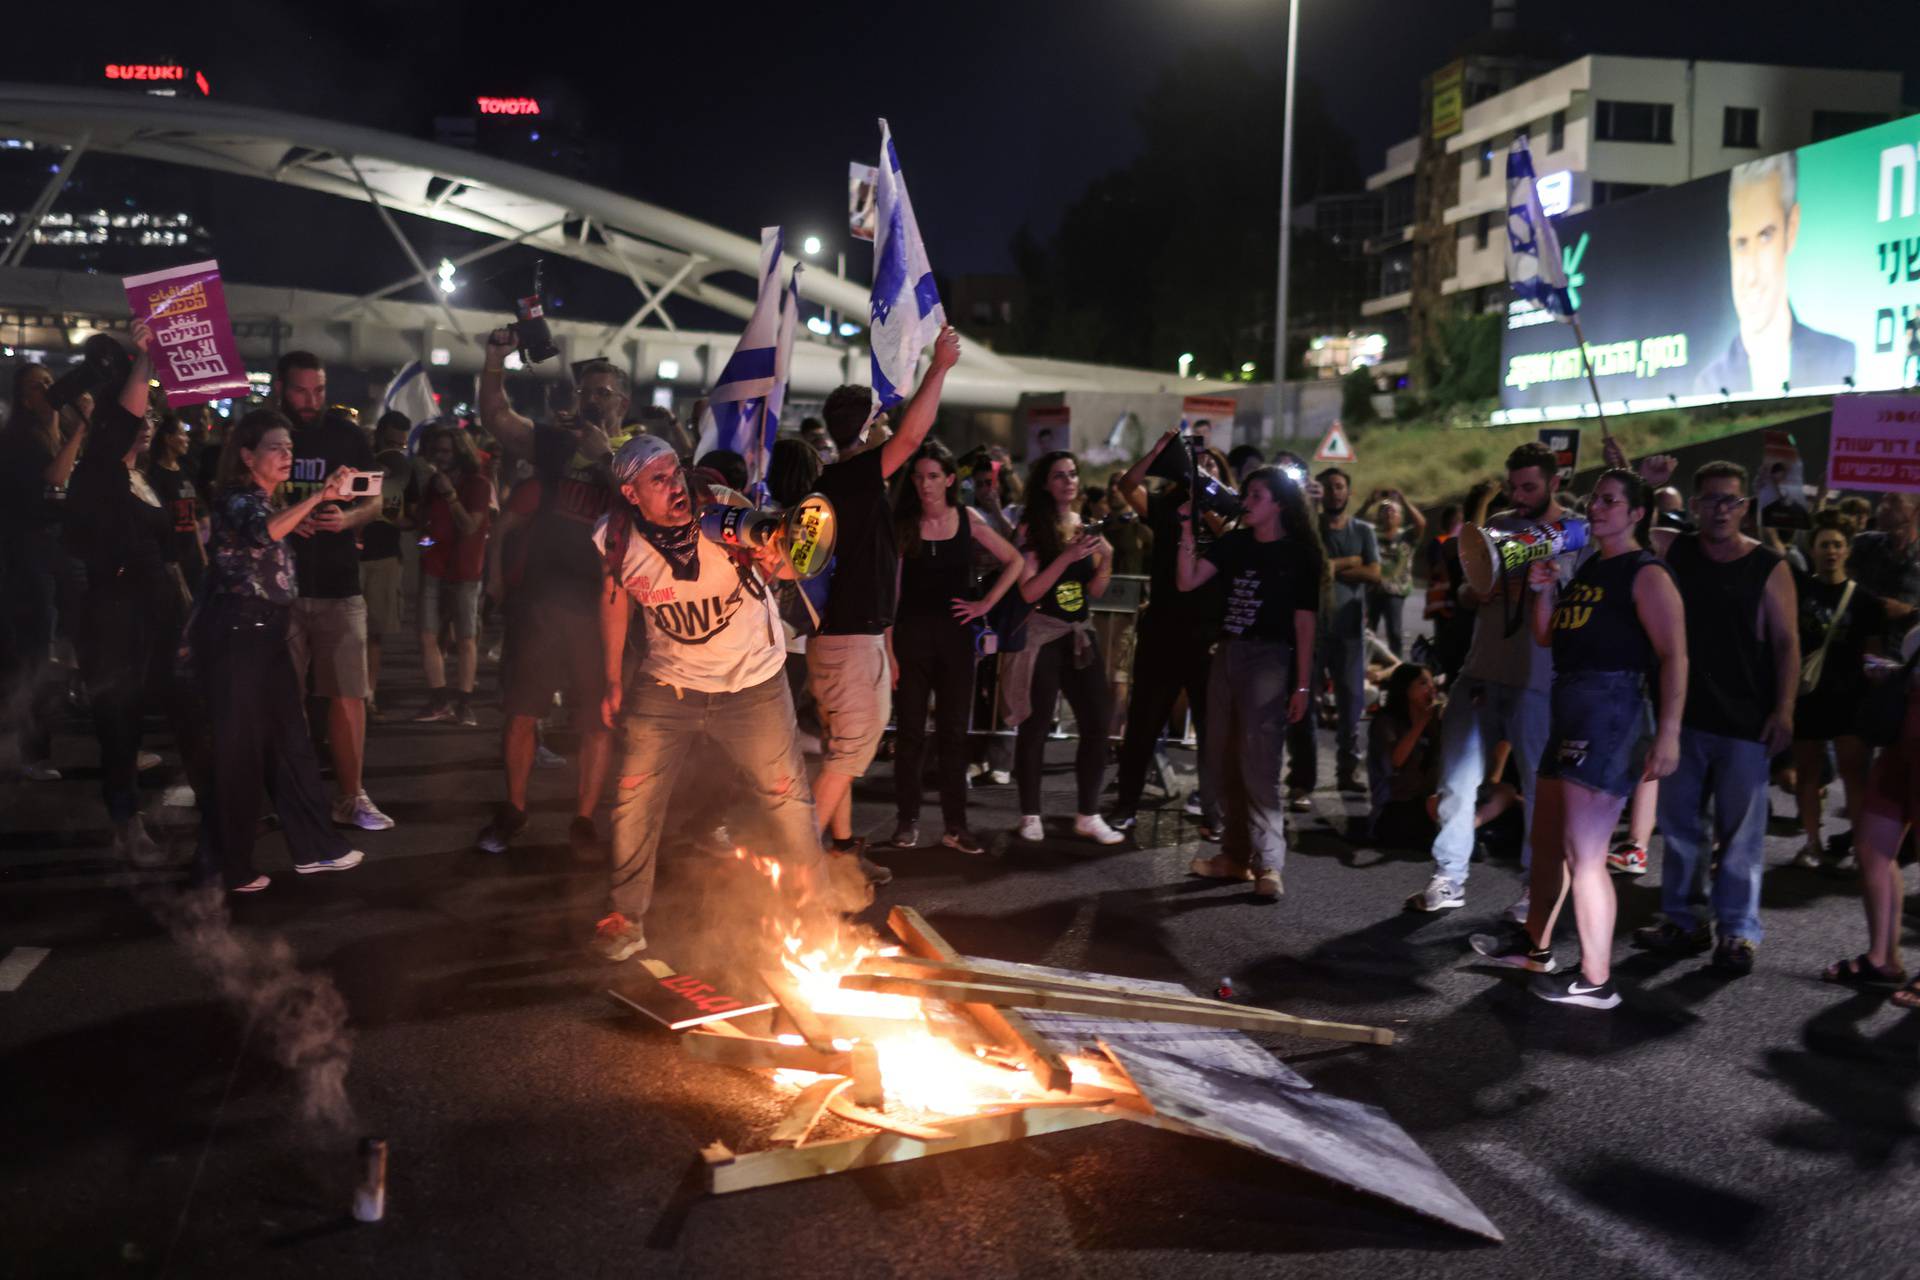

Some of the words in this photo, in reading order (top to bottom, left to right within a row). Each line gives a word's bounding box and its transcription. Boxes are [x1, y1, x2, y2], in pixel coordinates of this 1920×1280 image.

[105, 64, 183, 80] SUZUKI
[477, 96, 541, 115] TOYOTA
[153, 295, 207, 315] הסכמ
[160, 323, 212, 344] מצילים
[176, 359, 225, 378] חיים
[1835, 437, 1908, 454] דורשות
[650, 587, 677, 603] HOME
